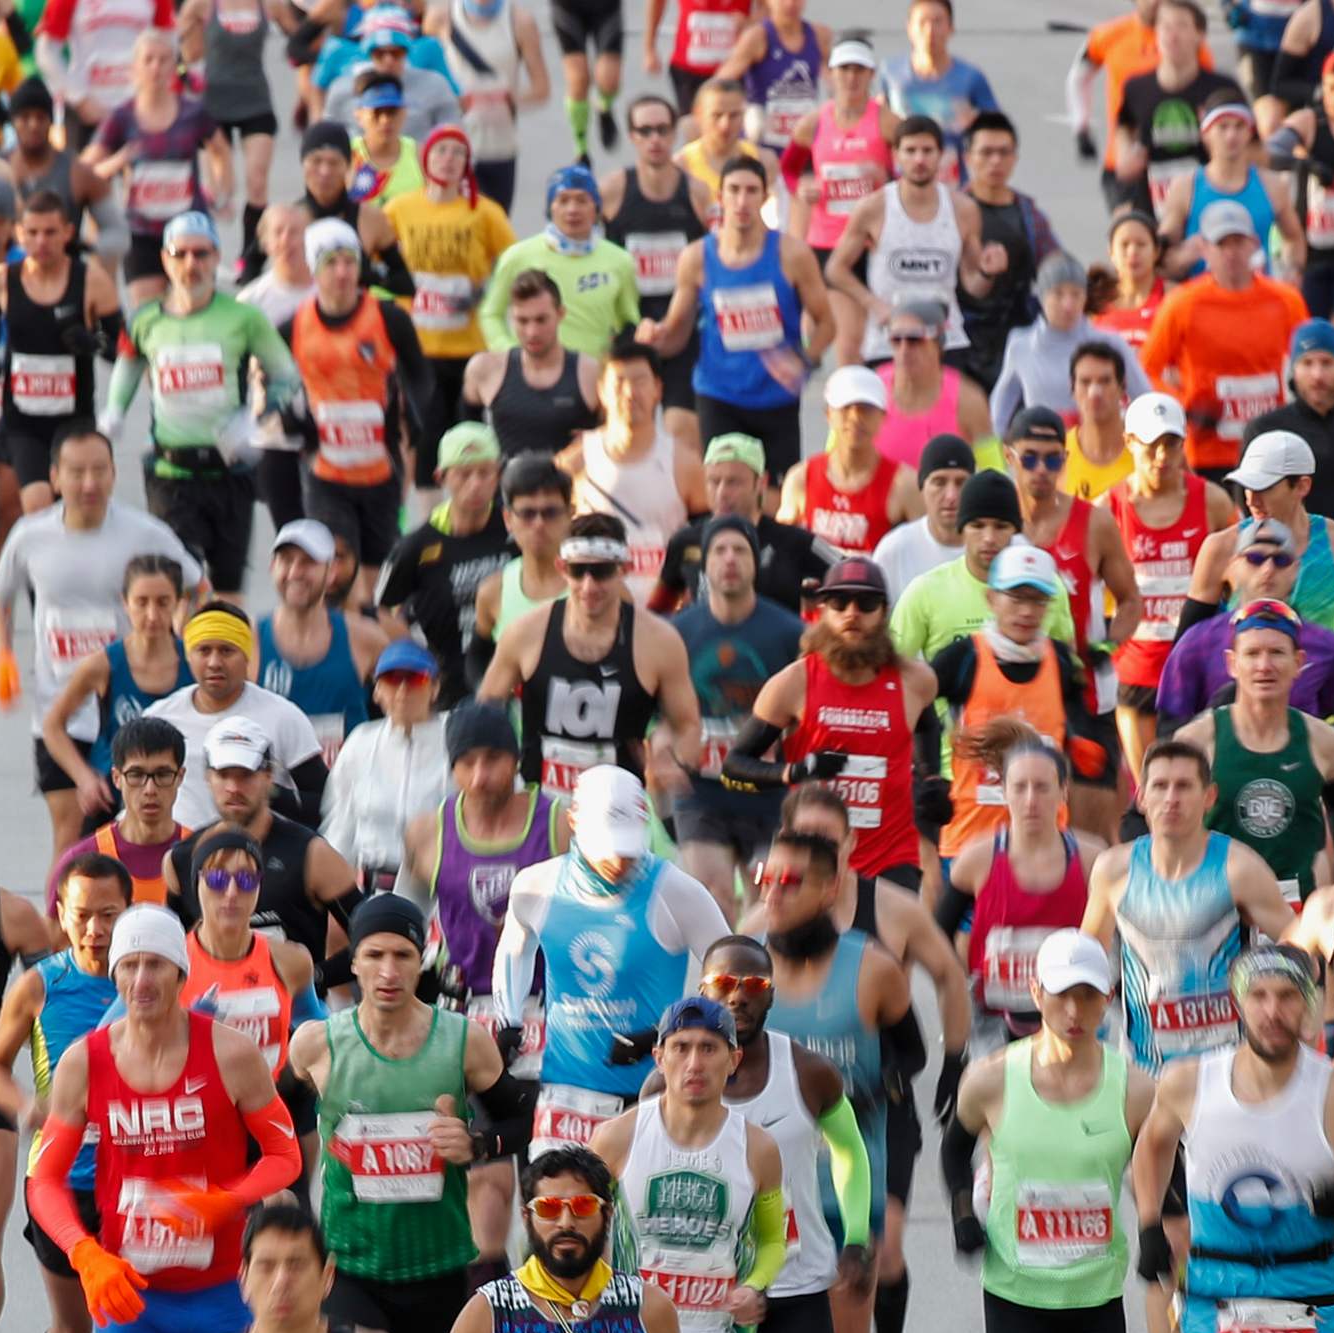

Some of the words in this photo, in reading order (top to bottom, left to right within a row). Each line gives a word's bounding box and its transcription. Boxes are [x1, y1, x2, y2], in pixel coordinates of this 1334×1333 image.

[1155, 1003, 1170, 1030] A
[108, 1096, 205, 1137] NRC
[363, 1147, 380, 1173] A
[1022, 1214, 1039, 1239] A
